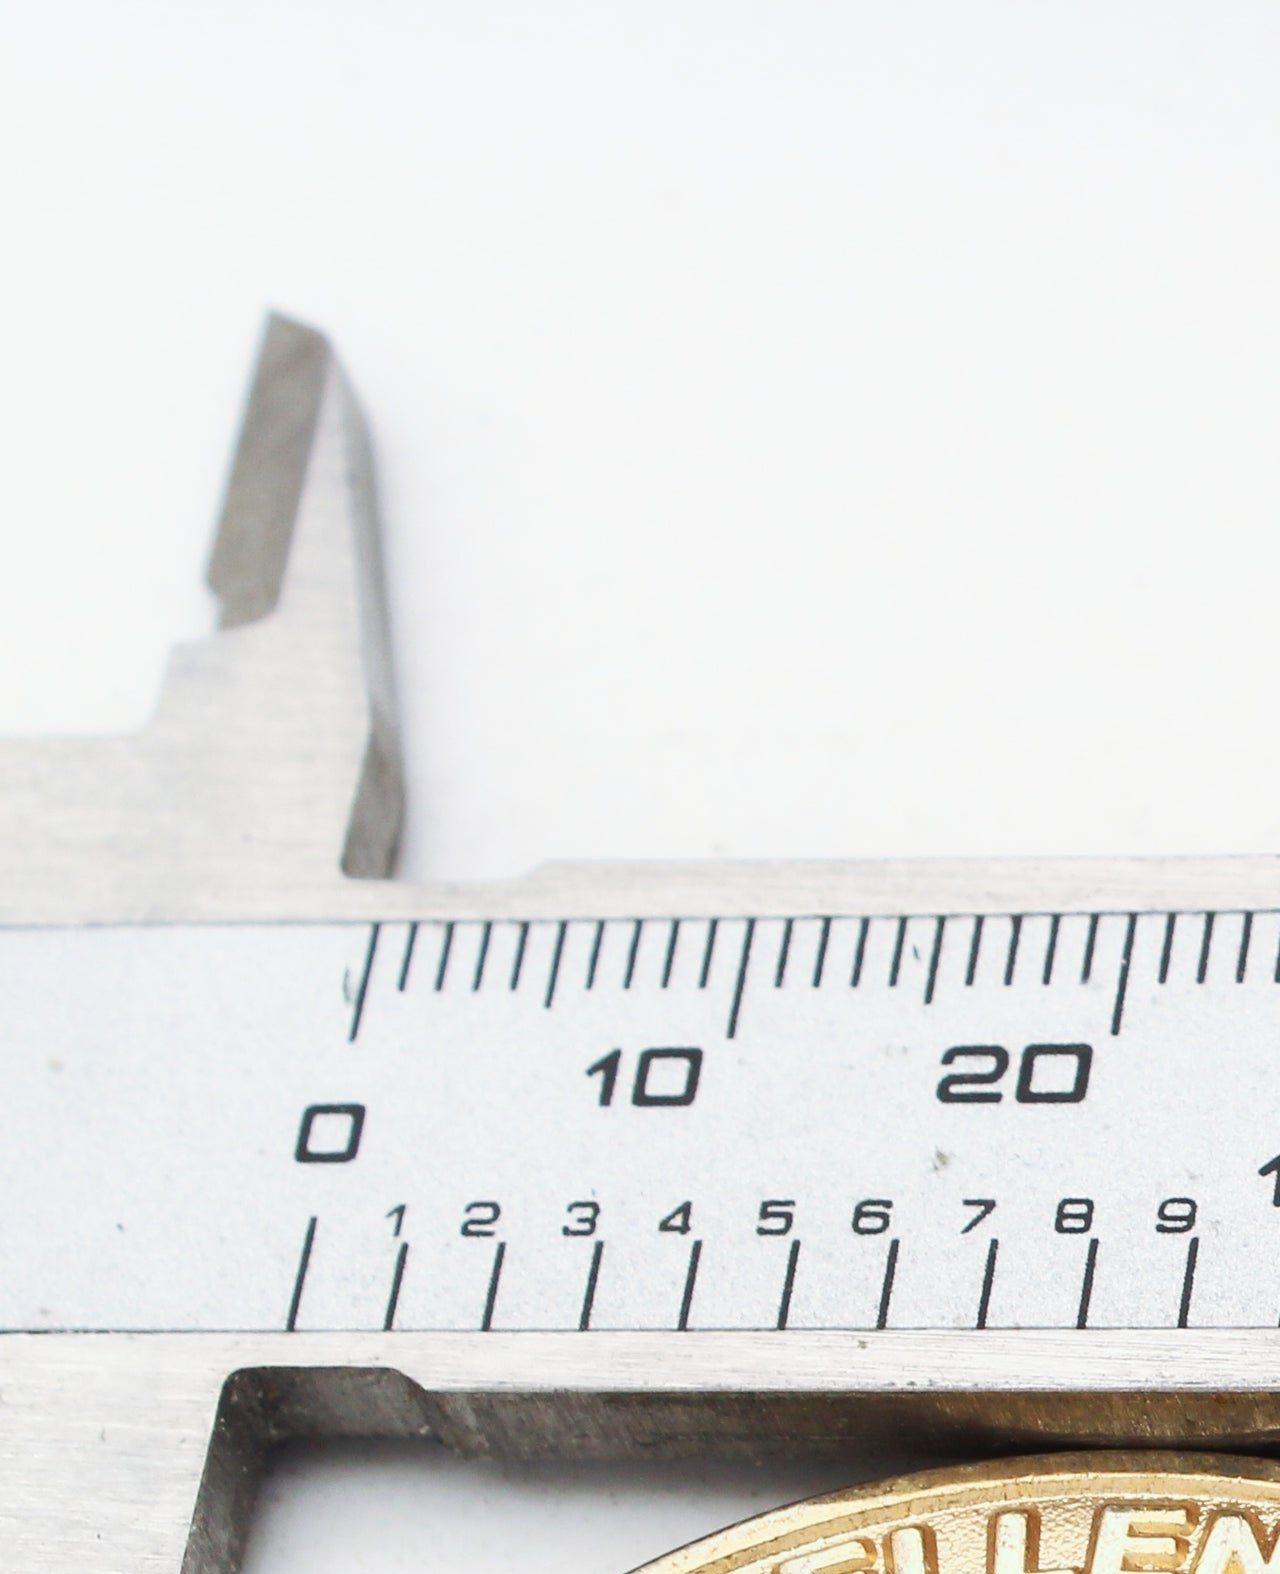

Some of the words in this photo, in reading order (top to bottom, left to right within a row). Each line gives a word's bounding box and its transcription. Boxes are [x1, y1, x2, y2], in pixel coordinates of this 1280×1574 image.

[587, 1048, 703, 1106] 10
[937, 1044, 1093, 1103] 20
[295, 1104, 365, 1163] 0
[386, 1204, 407, 1237] 1
[462, 1202, 501, 1237] 2
[563, 1202, 600, 1236] 3
[658, 1201, 692, 1235] 4
[757, 1200, 795, 1235] 5
[852, 1200, 892, 1235] 6
[962, 1199, 996, 1233] 7
[1055, 1198, 1094, 1233] 8
[1156, 1197, 1197, 1233] 9
